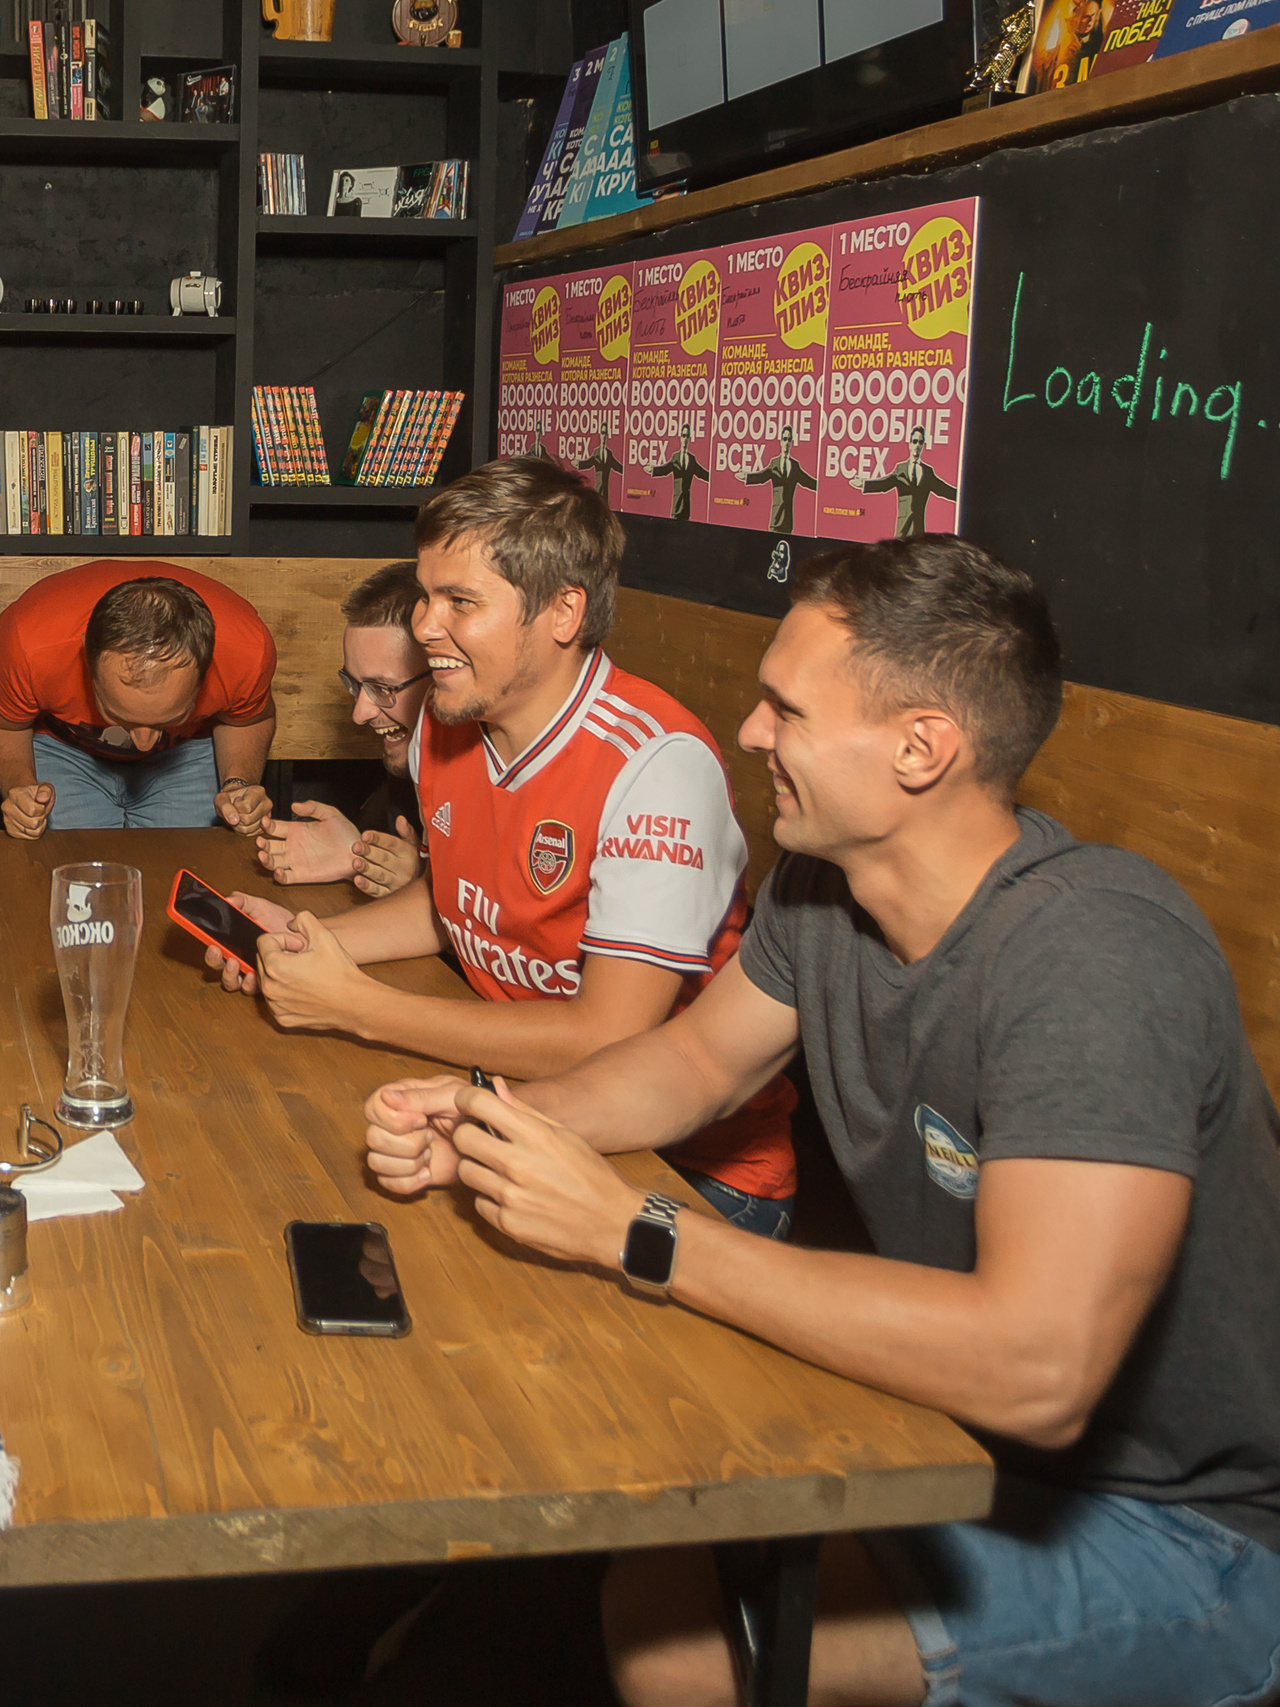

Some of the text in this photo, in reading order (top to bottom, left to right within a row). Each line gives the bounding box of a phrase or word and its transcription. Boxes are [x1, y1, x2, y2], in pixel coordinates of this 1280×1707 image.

[1103, 14, 1168, 52] ПОБЕД
[33, 46, 42, 77] ГАРИН
[840, 222, 911, 255] 1 МЕСТО
[728, 246, 783, 274] 1 МЕСТО
[571, 277, 602, 298] МЕСТО
[638, 263, 683, 287] 1 МЕСТО
[838, 264, 908, 294] Бескрайняя
[722, 343, 769, 359] КОМАНДЕ,
[833, 333, 892, 351] КОМАНДЕ,
[633, 350, 670, 364] КОМАНДЕ,
[721, 358, 814, 376] КОТОРАЯ РАЗНЕСЛА
[832, 349, 953, 369] КОТОРАЯ РАЗНЕСЛА
[561, 368, 621, 381] КОТОРАЯ РАЗНЕСЛА
[632, 364, 708, 378] КОТОРАЯ РАЗНЕСЛА
[559, 436, 591, 460] ВСЕХ
[628, 439, 668, 466] ВСЕХ
[716, 443, 766, 472] ВСЕХ
[825, 445, 889, 480] ВСЕХ
[626, 814, 691, 840] VISIT
[536, 832, 565, 849] Arsenal
[601, 837, 704, 870] RWANDA
[457, 877, 500, 936] Fly
[443, 915, 581, 996] mirates
